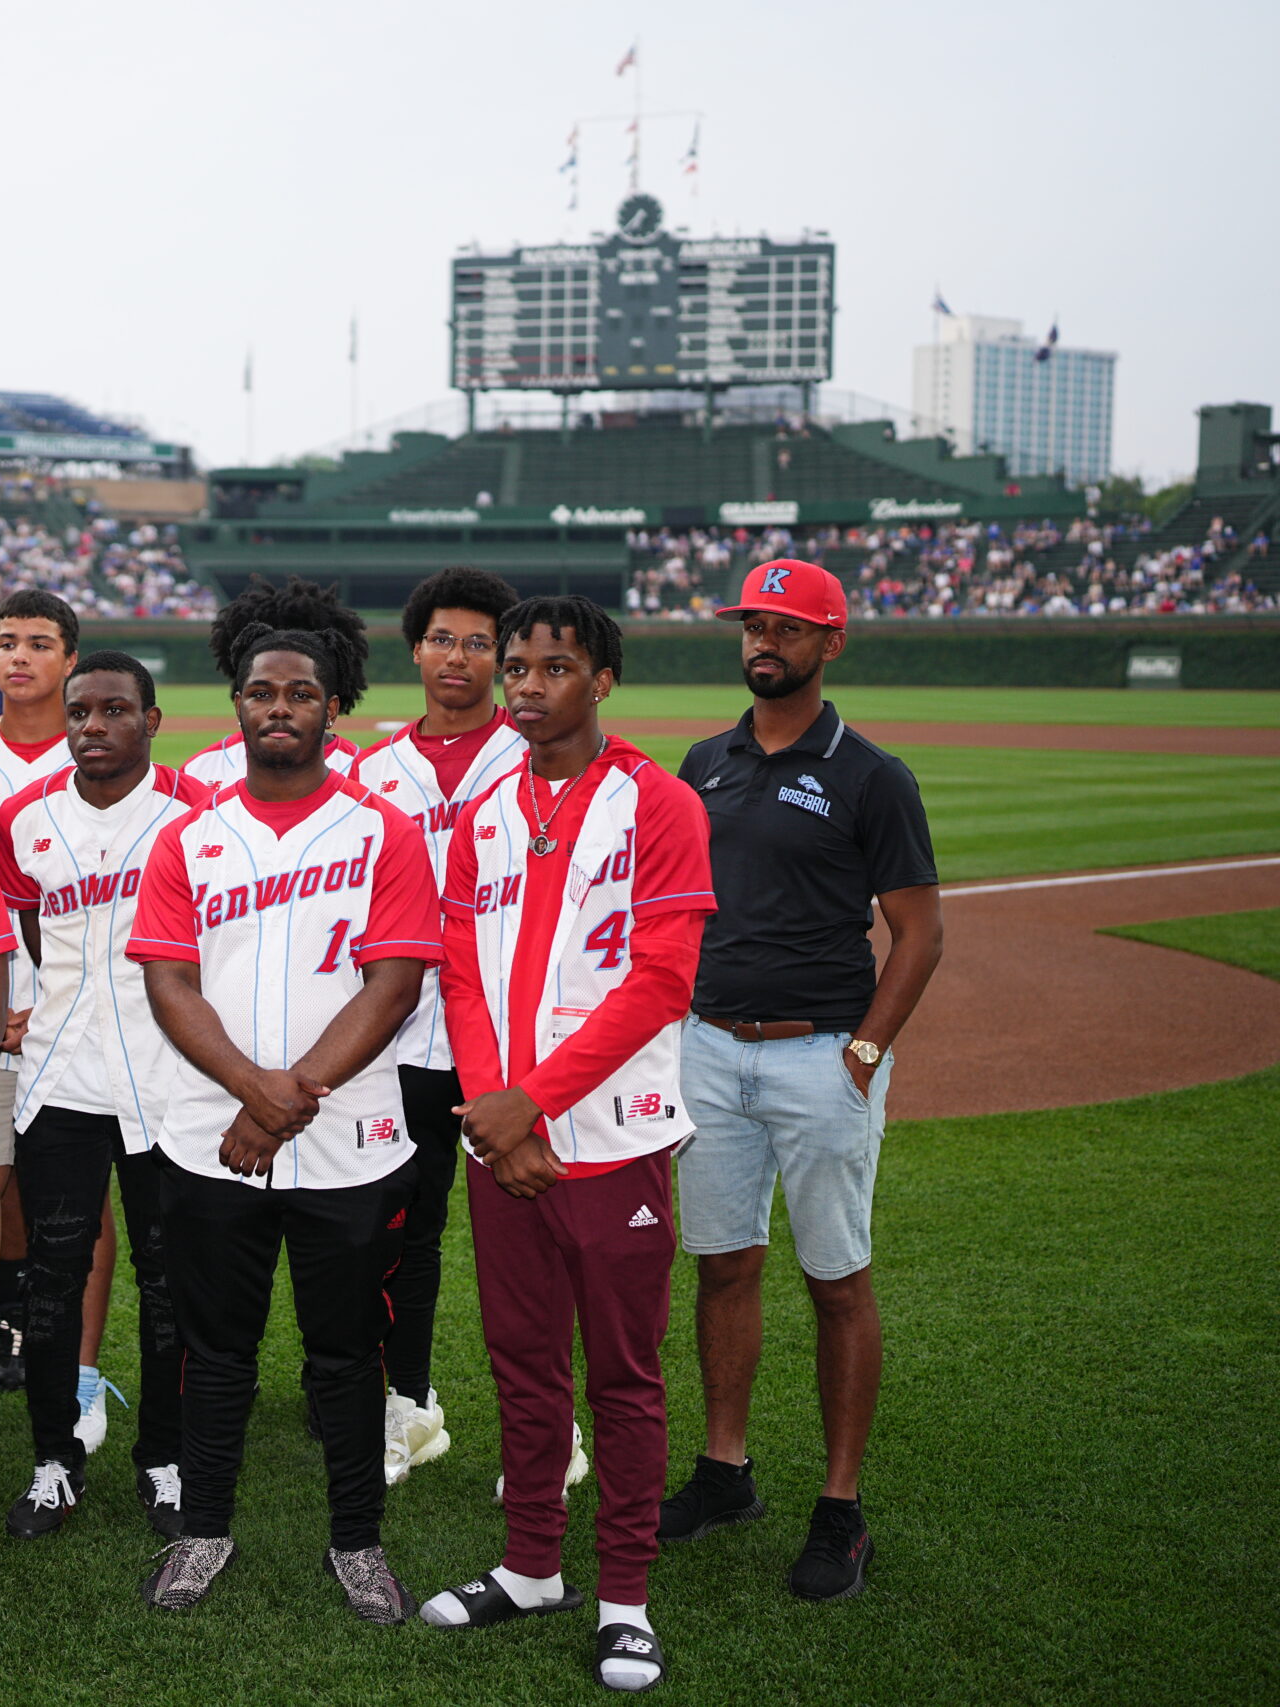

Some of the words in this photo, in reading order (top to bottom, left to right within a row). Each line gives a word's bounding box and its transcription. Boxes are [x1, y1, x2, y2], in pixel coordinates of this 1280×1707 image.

[759, 568, 791, 594] K
[379, 779, 399, 794] NB
[778, 786, 830, 817] BASEBALL
[474, 825, 497, 841] NB
[32, 838, 51, 853] NB
[196, 844, 223, 858] NB
[628, 1217, 659, 1227] adidas
[612, 1633, 653, 1654] NB
